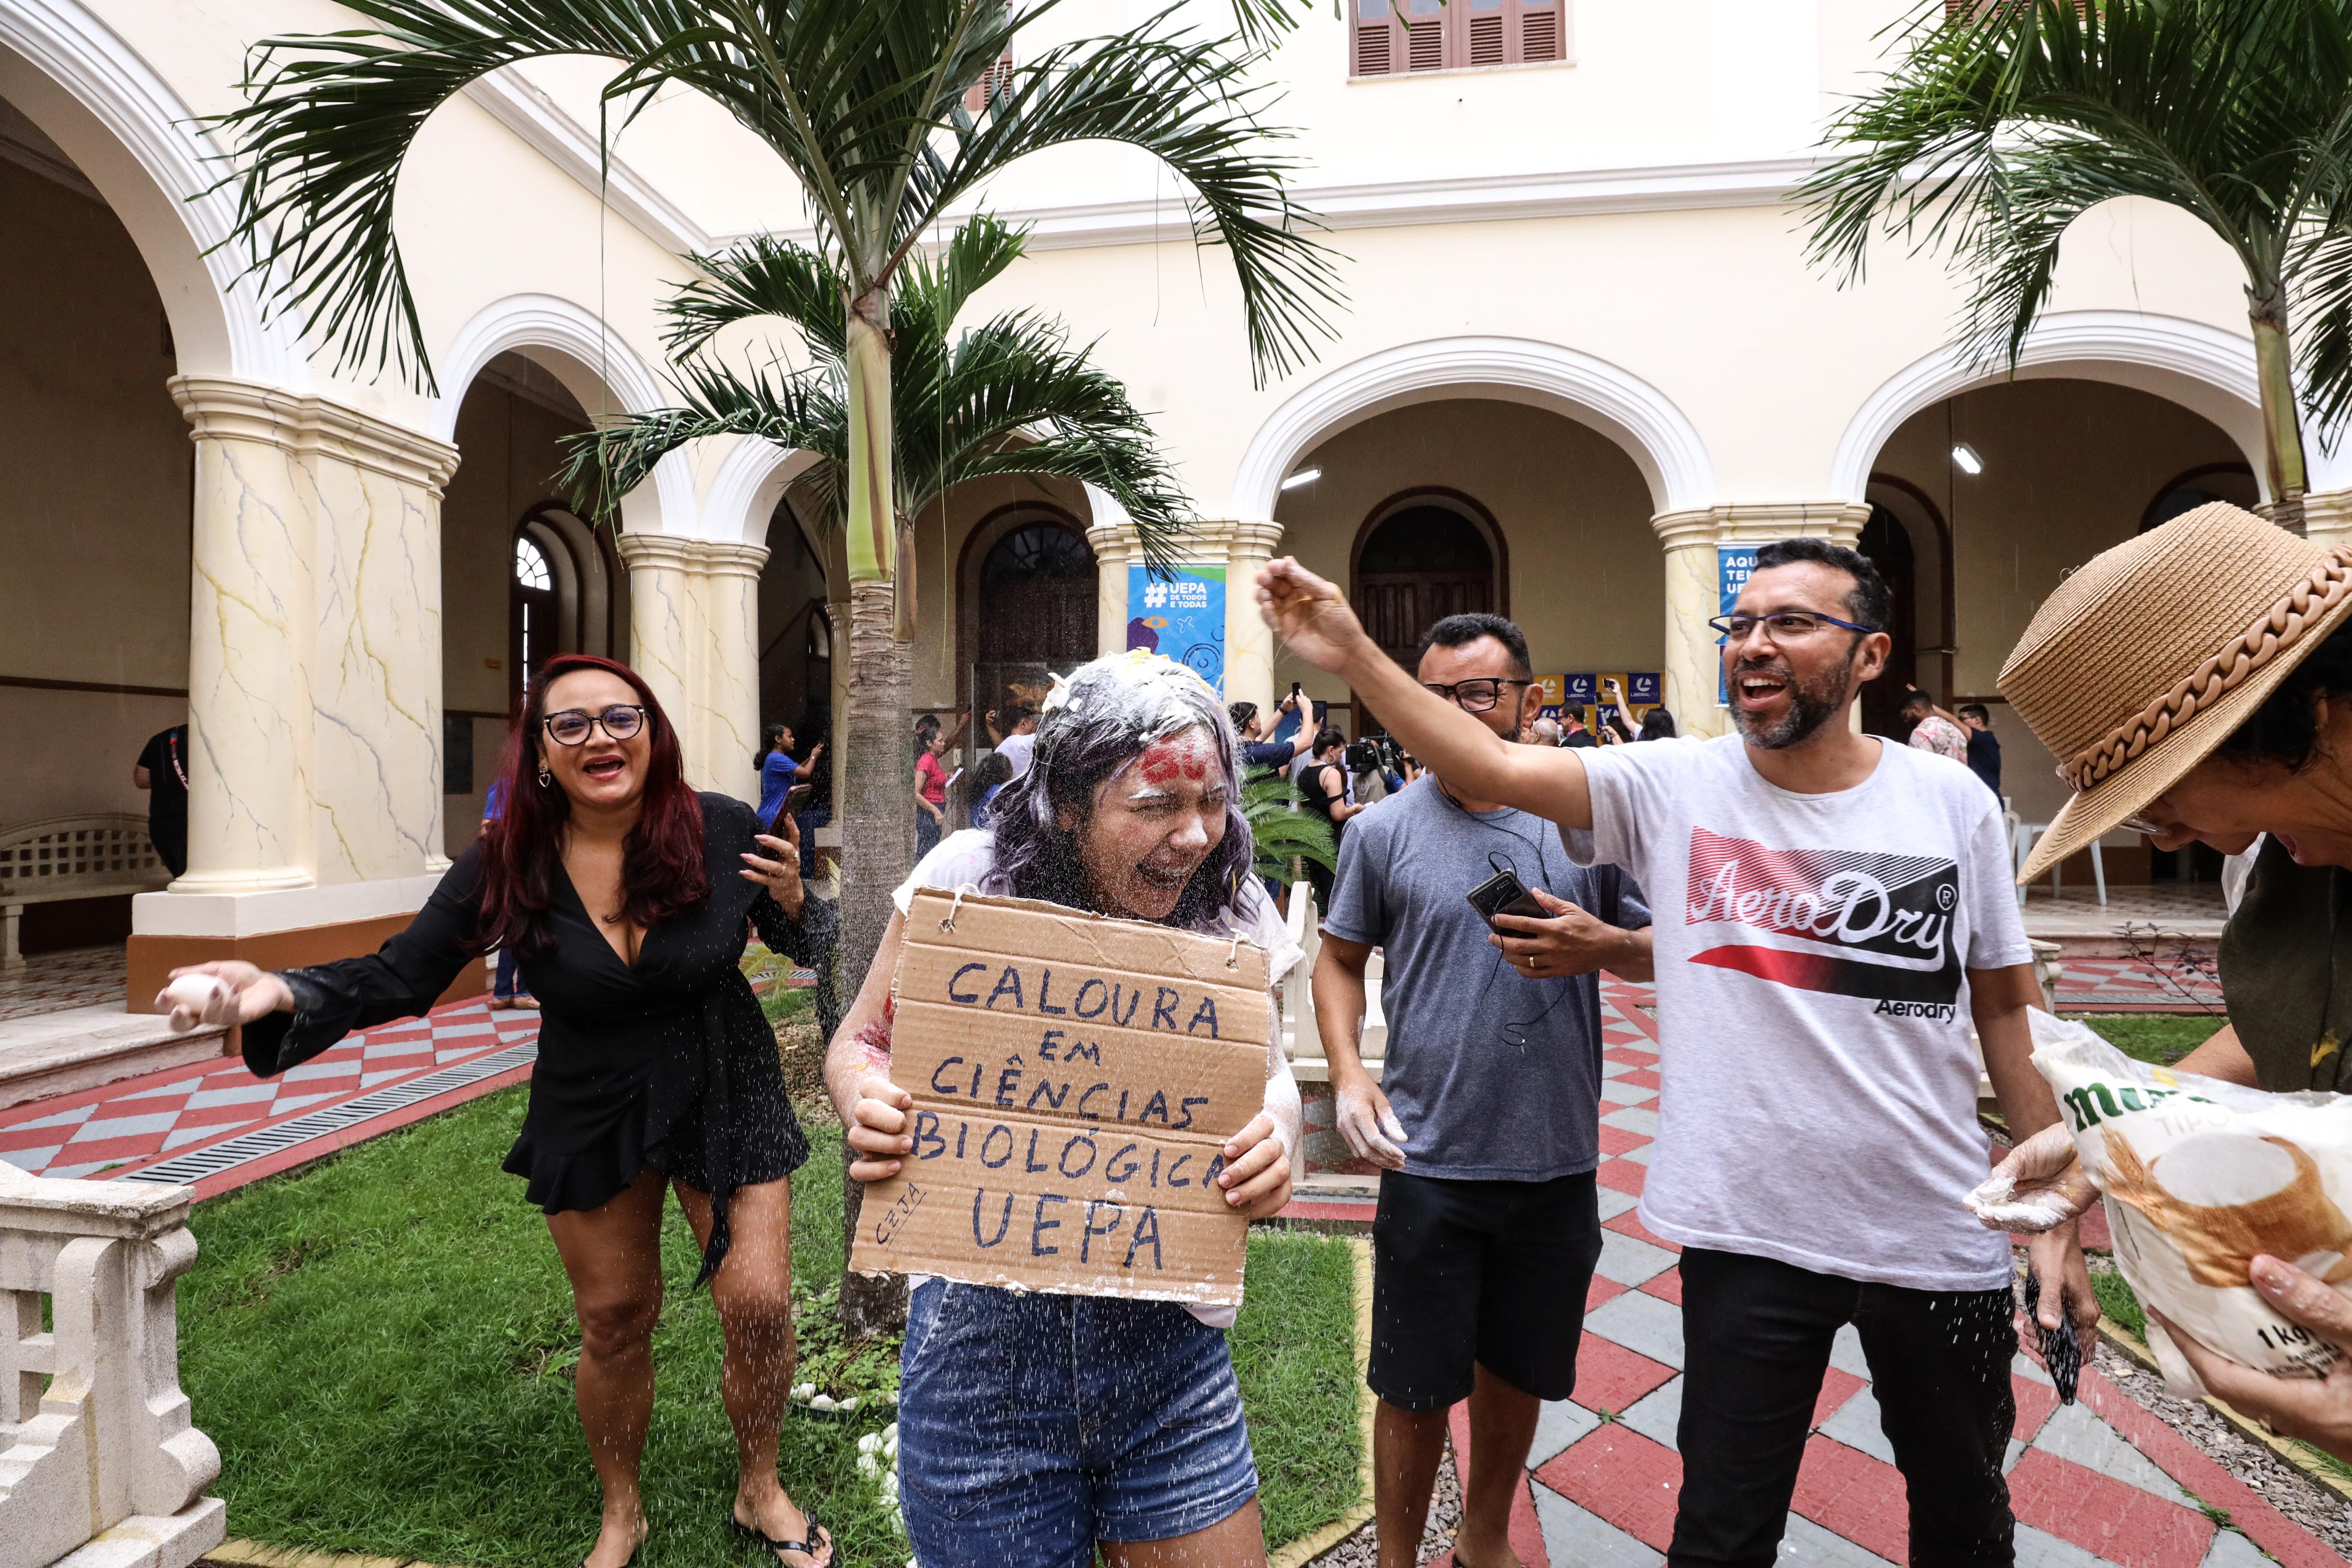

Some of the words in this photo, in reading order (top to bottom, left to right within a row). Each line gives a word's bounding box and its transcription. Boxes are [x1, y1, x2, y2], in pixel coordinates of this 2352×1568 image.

[1726, 556, 1758, 567] AQU
[1170, 583, 1207, 594] UEPA
[1727, 583, 1746, 594] UE
[948, 962, 1218, 1038] CALOURA
[1874, 999, 1956, 1024] Aerodry
[1038, 1030, 1100, 1066] EM
[931, 1054, 1209, 1129] CIÊNCIAS
[972, 1187, 1163, 1270] UEPA
[2257, 1328, 2276, 1349] 1
[2272, 1324, 2310, 1346] kg
